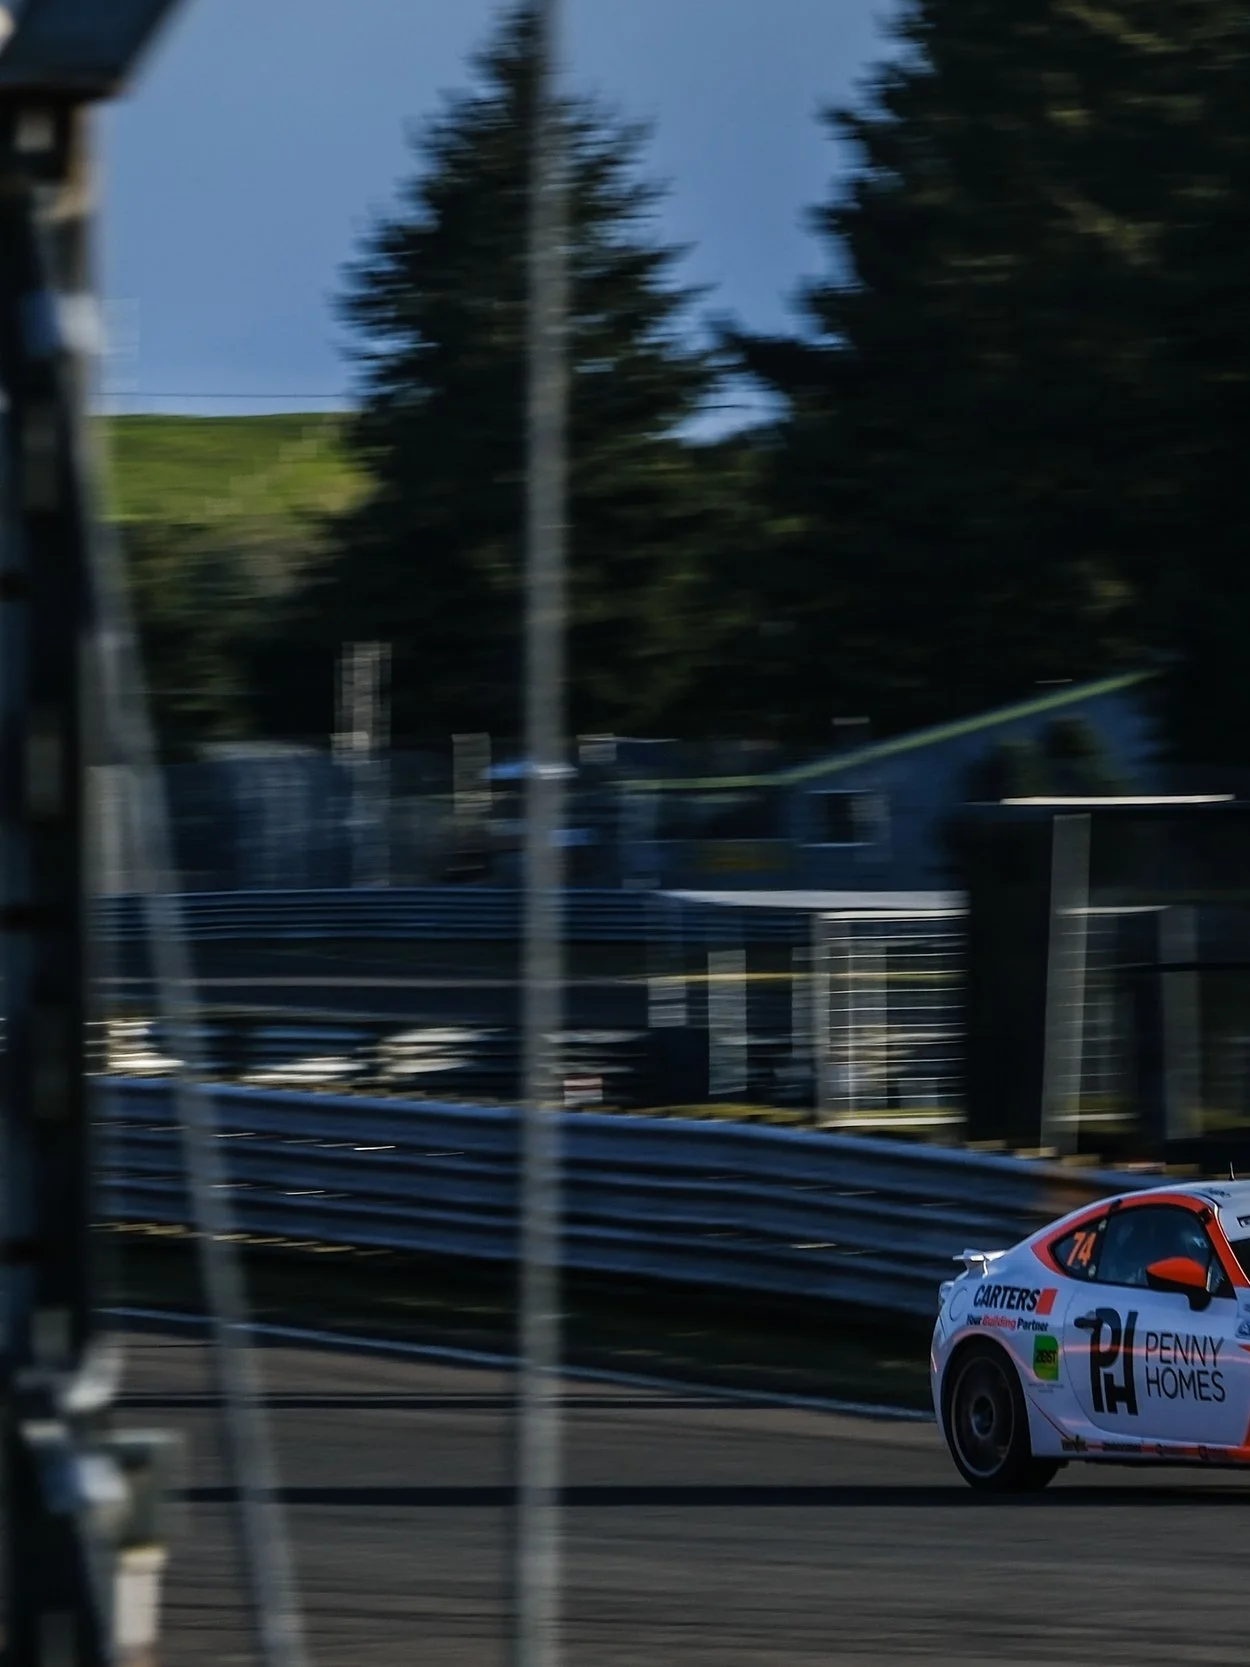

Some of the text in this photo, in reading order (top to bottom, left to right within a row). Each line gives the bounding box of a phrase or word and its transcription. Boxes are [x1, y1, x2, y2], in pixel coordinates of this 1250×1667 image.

[1067, 1231, 1097, 1267] 74
[974, 1284, 1041, 1312] CARTERS
[1017, 1318, 1049, 1331] Partner
[1145, 1331, 1225, 1368] PENNY
[1145, 1365, 1226, 1403] HOMES
